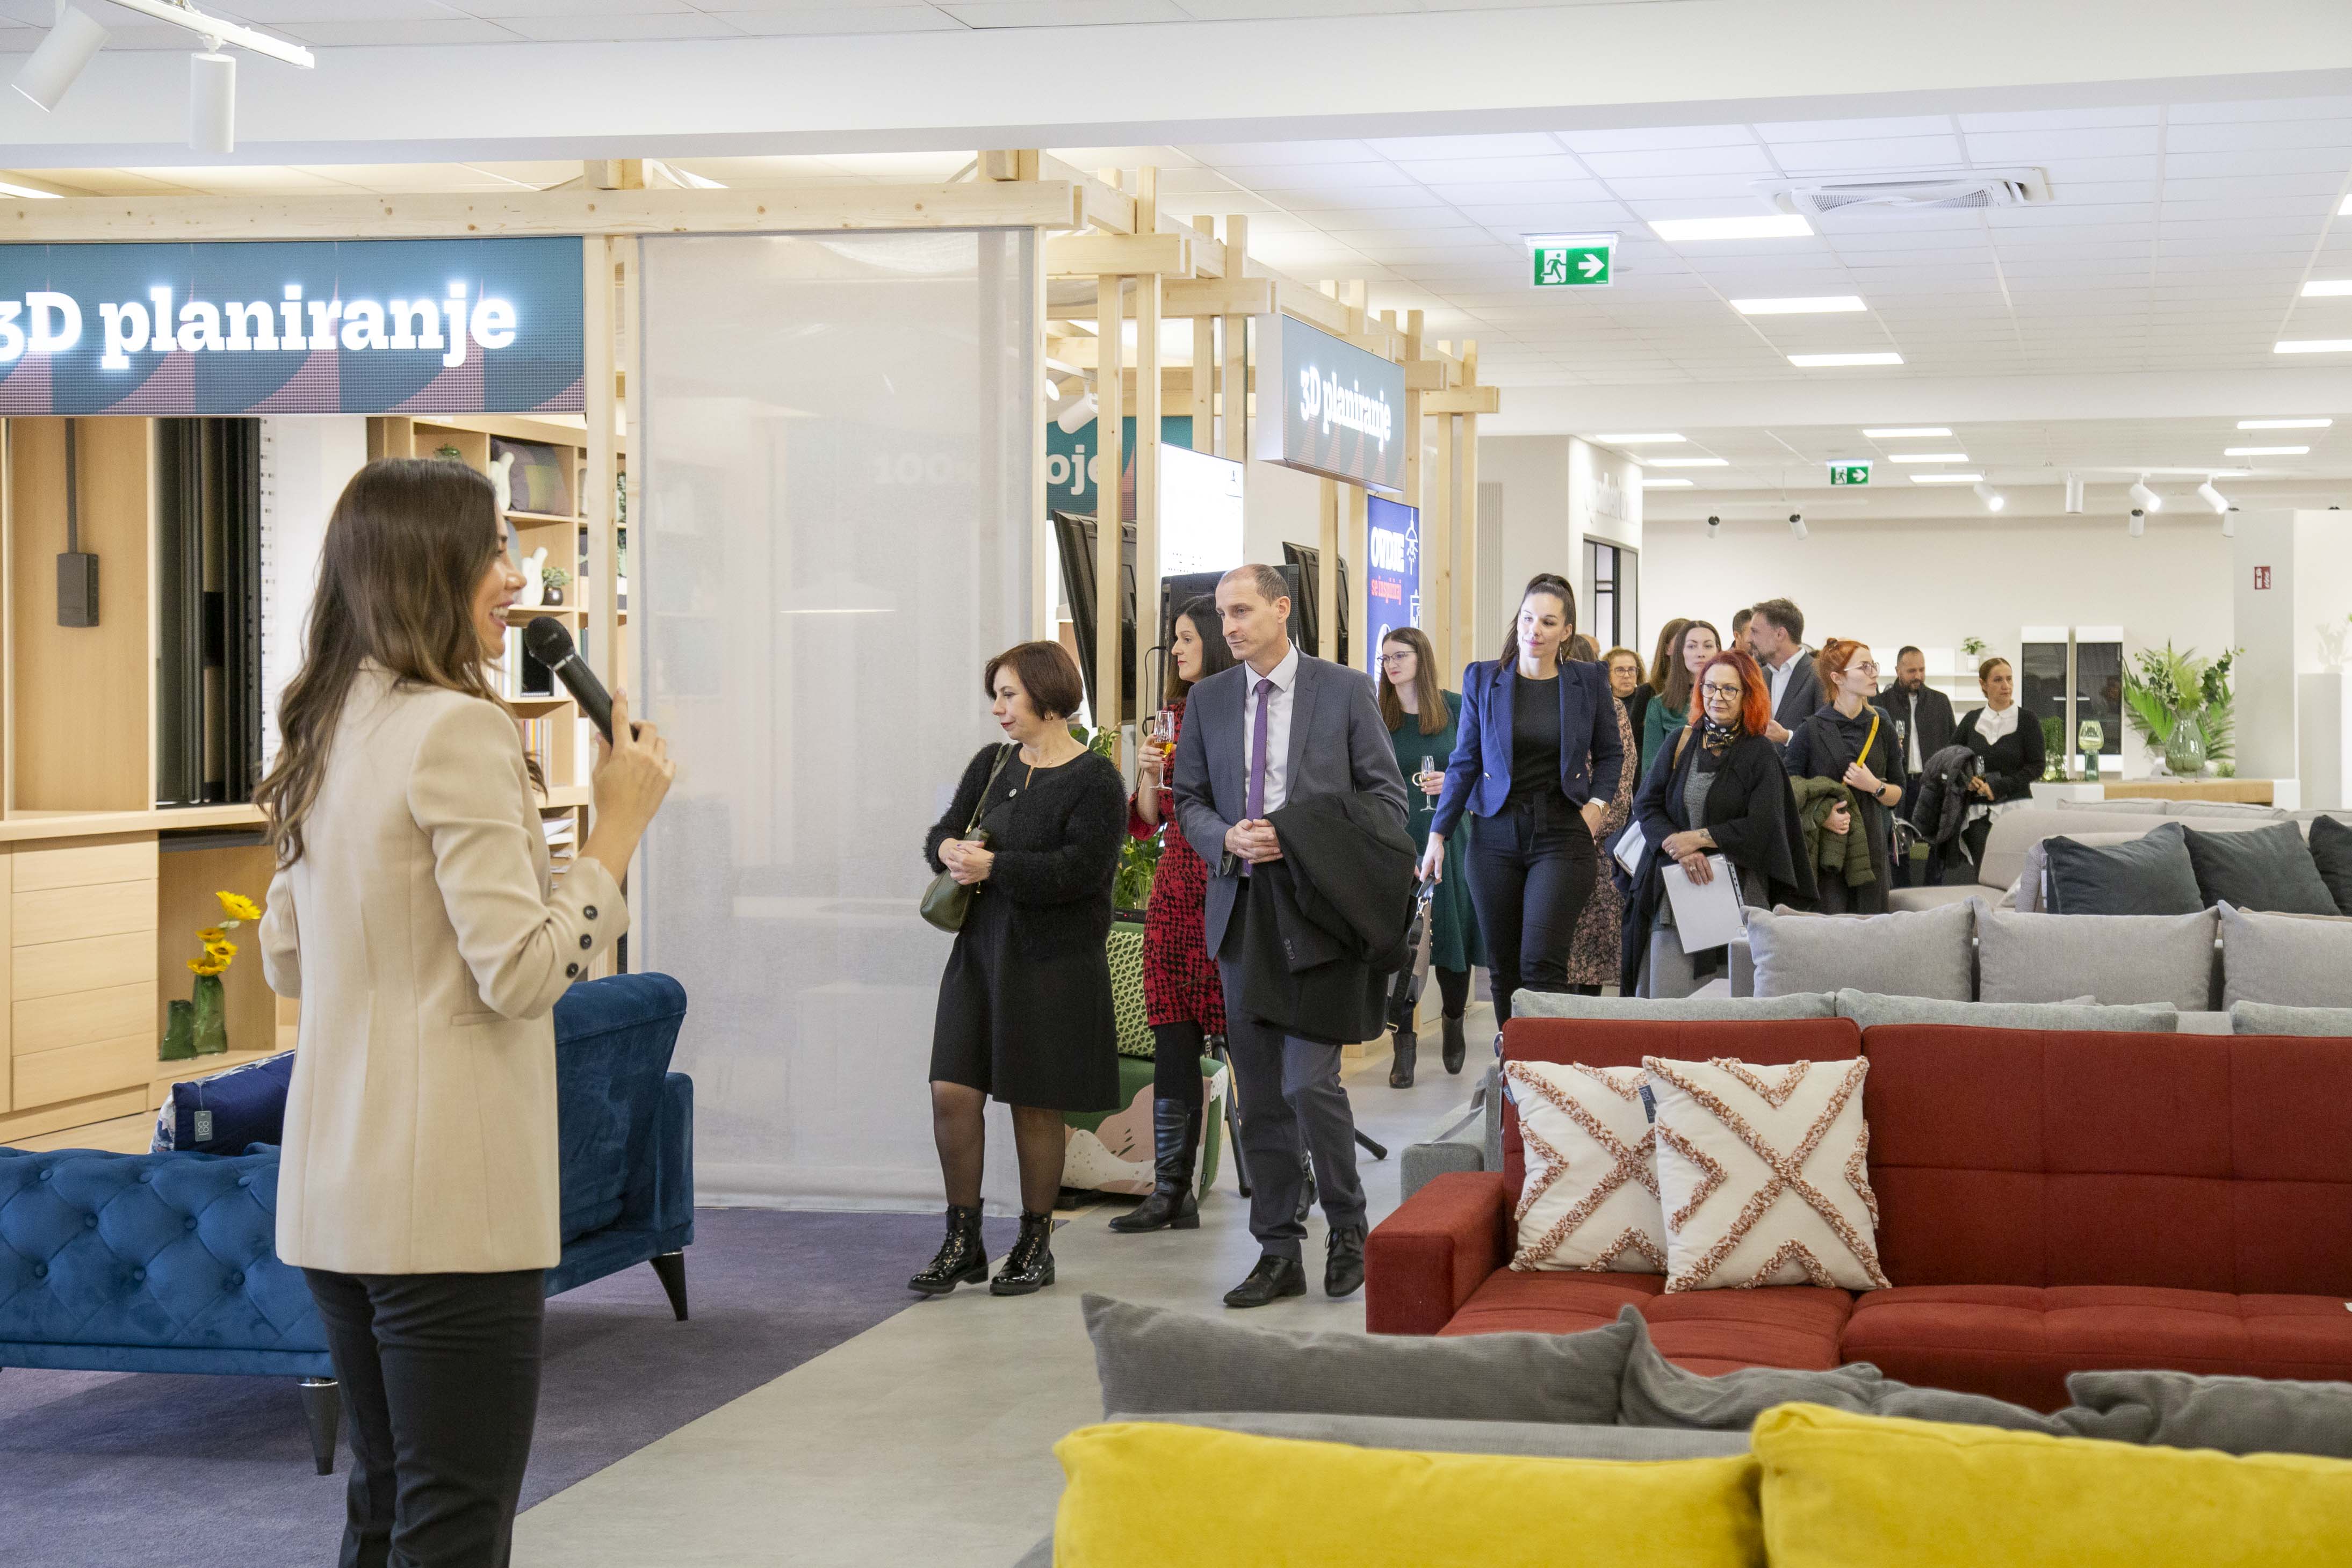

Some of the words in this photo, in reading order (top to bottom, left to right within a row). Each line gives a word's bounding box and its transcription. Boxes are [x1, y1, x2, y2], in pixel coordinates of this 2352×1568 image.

[0, 291, 83, 362] 3D
[99, 283, 516, 370] planiranje
[1300, 365, 1322, 422] 3D
[1323, 371, 1391, 452] planiranje
[1372, 579, 1378, 596] se
